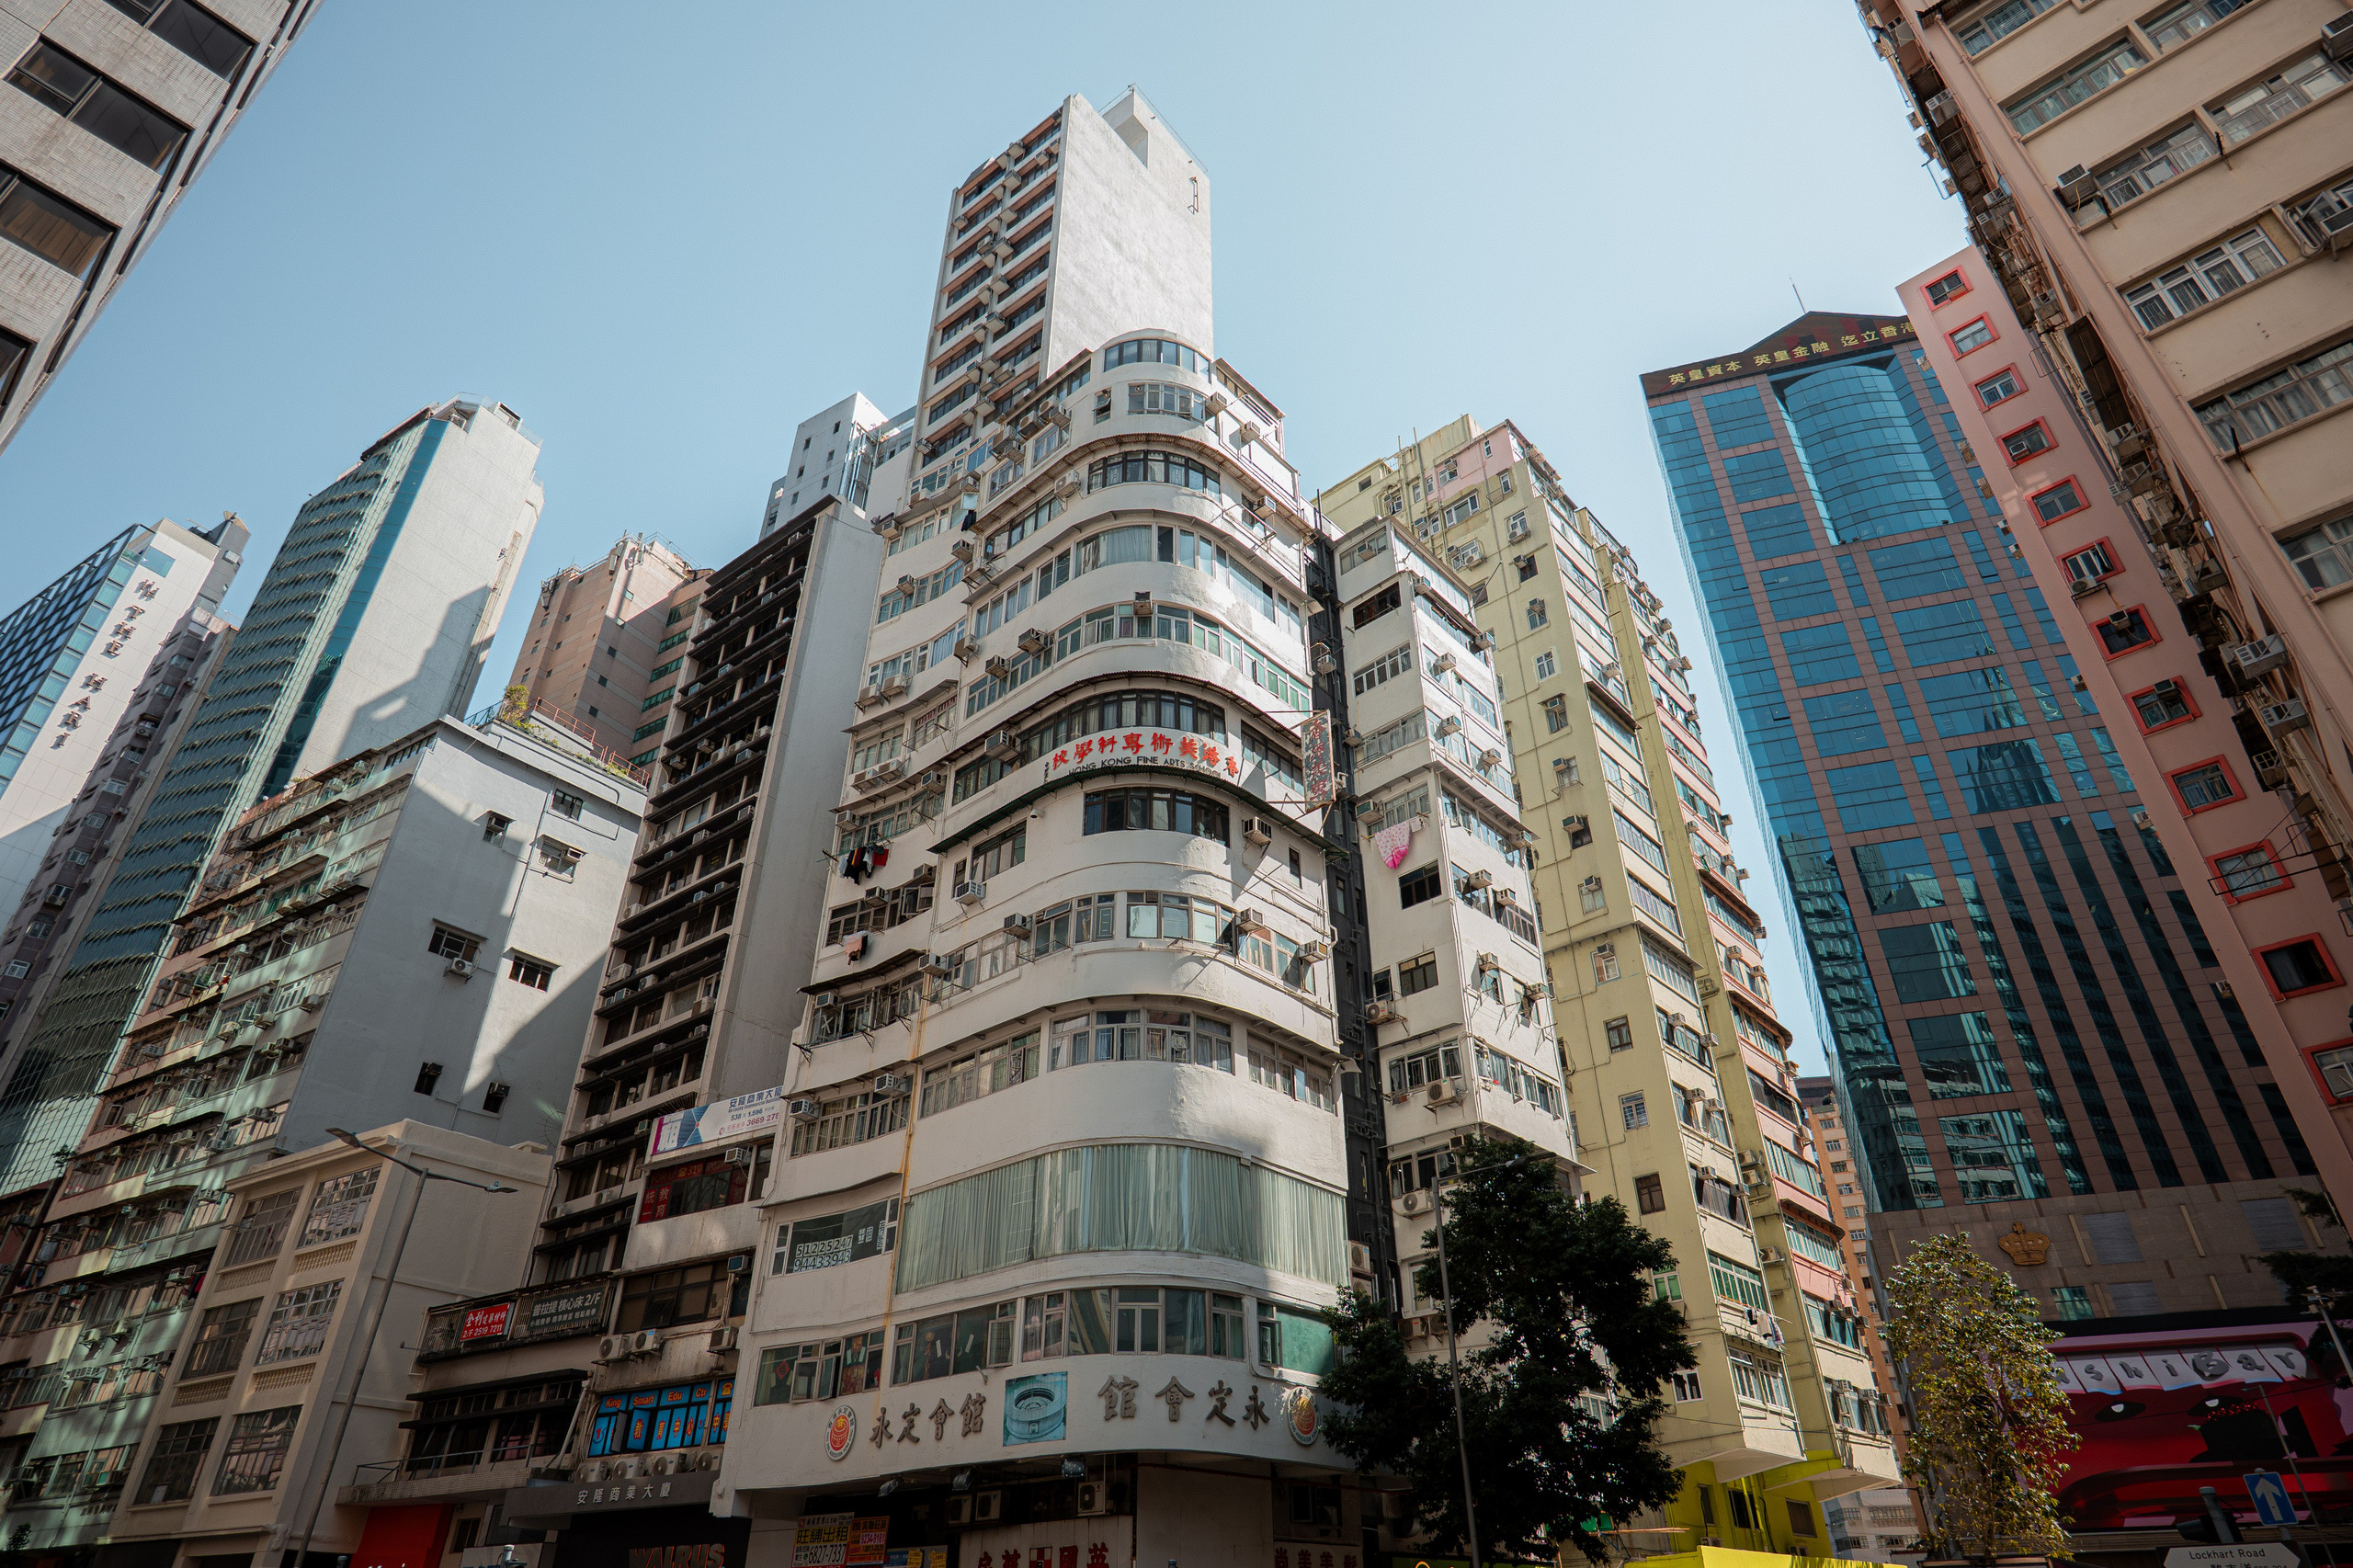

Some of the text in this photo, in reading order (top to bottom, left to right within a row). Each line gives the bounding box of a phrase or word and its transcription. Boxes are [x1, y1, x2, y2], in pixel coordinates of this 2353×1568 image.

[1668, 361, 1742, 385] 英皇資本
[1754, 341, 1830, 366] 英皇金融
[108, 604, 146, 657] THE
[58, 672, 108, 747] HARI
[1069, 762, 1097, 775] HONG
[1101, 756, 1132, 767] KONG
[1136, 756, 1159, 765] FINE
[1164, 758, 1187, 768] ARTS
[746, 1116, 765, 1127] 3669
[655, 1186, 671, 1218] 教育
[797, 1236, 852, 1256] 51225247
[585, 1292, 602, 1306] 2/F
[605, 1388, 708, 1409] King Smart Edu Ctr
[1097, 1375, 1270, 1430] 永定會館
[869, 1392, 987, 1449] 永定會館
[576, 1482, 672, 1506] 安隆商業大廈
[809, 1544, 847, 1564] 6827-7337
[2189, 1548, 2267, 1560] Lockhart Road
